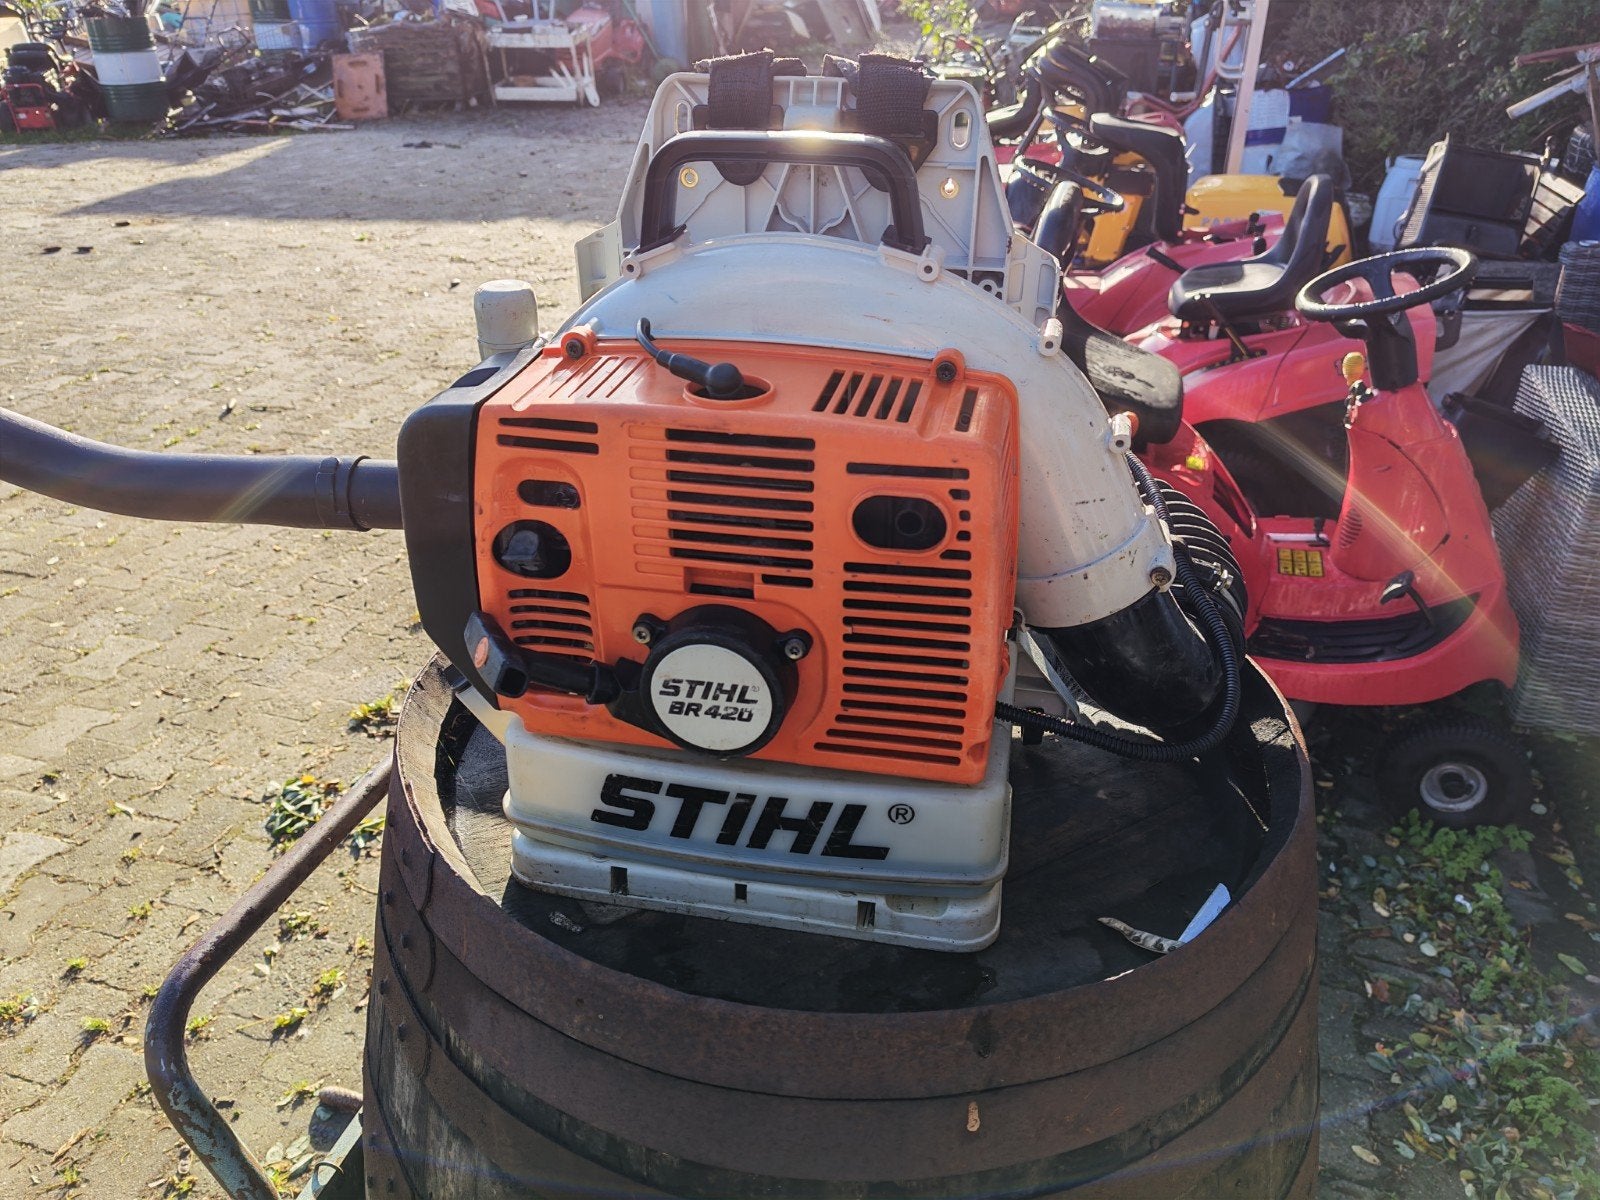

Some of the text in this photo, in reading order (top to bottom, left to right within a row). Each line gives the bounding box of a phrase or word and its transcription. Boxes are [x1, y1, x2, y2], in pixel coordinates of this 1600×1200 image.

[668, 701, 753, 722] BR 420
[590, 773, 890, 860] STIHL
